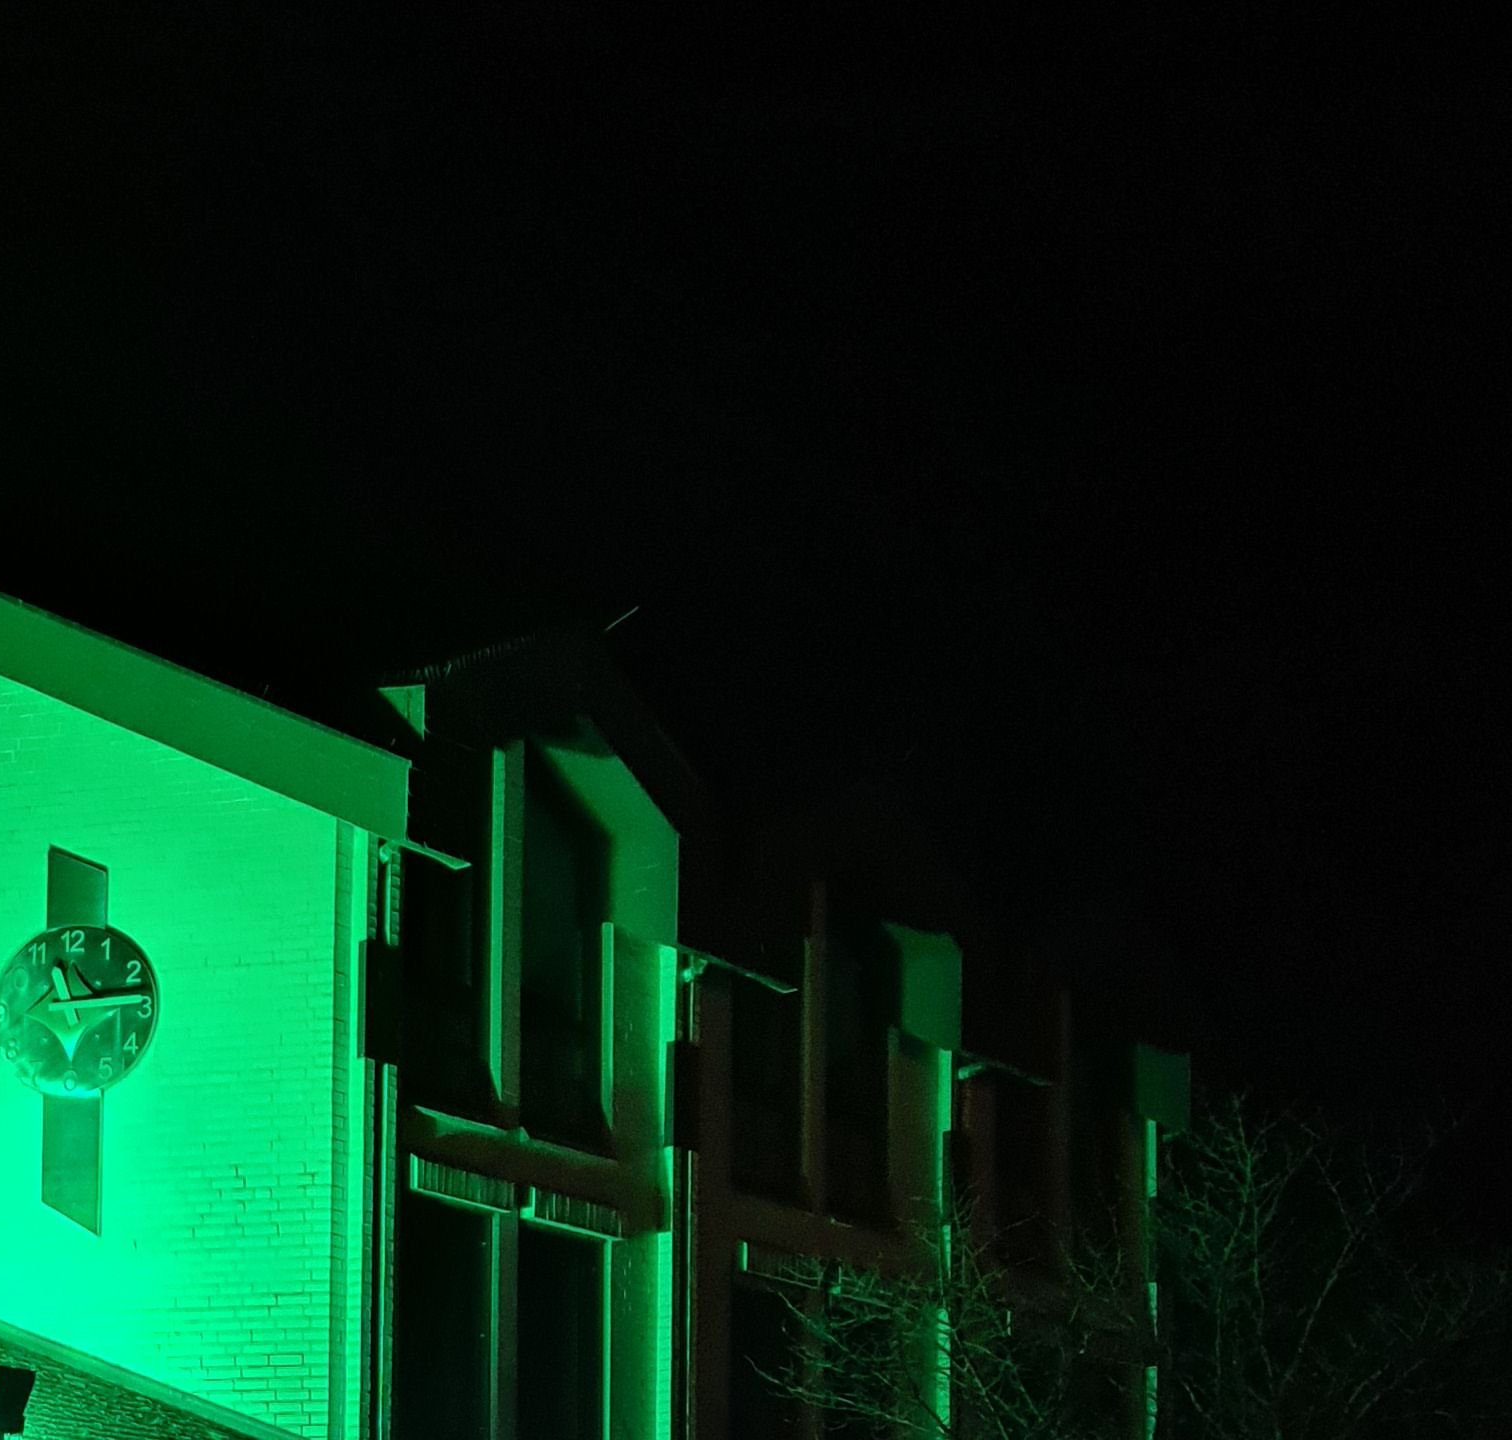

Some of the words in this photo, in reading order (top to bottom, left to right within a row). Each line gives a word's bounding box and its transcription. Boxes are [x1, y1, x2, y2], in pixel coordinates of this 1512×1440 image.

[61, 930, 85, 953] 12
[101, 938, 111, 960] 1
[28, 942, 46, 965] 11
[126, 960, 141, 984] 2
[137, 996, 152, 1018] 3
[123, 1032, 138, 1055] 4
[99, 1057, 113, 1080] 5
